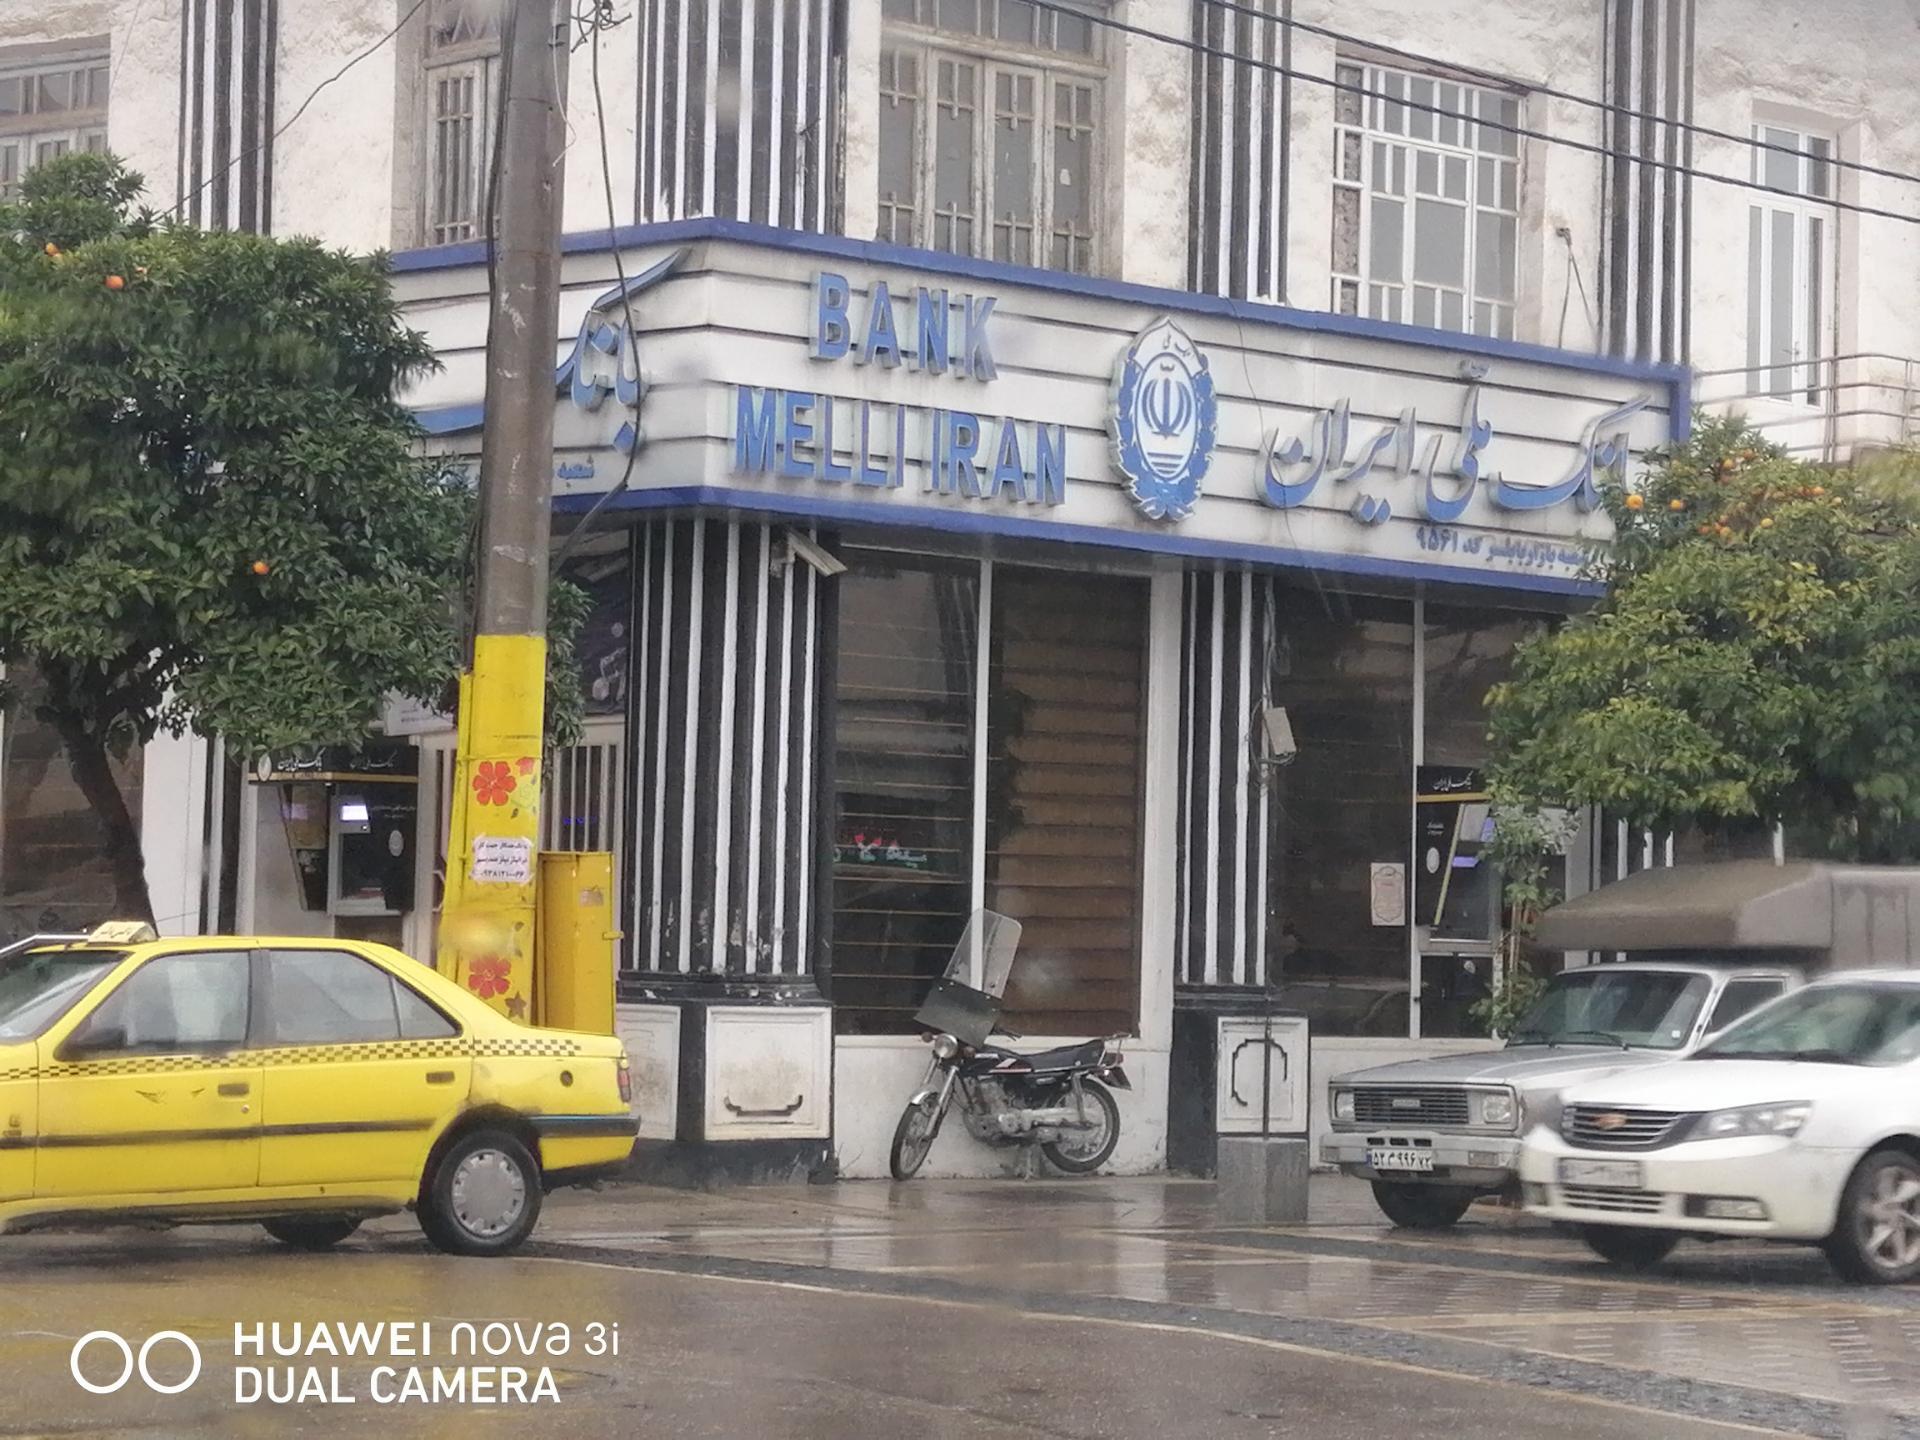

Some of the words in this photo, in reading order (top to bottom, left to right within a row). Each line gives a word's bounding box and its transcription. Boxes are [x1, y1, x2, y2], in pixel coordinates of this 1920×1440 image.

[810, 272, 998, 382] BANK
[735, 384, 906, 489] MELLI
[927, 408, 1066, 505] IRAN
[1257, 397, 1417, 526] ایران
